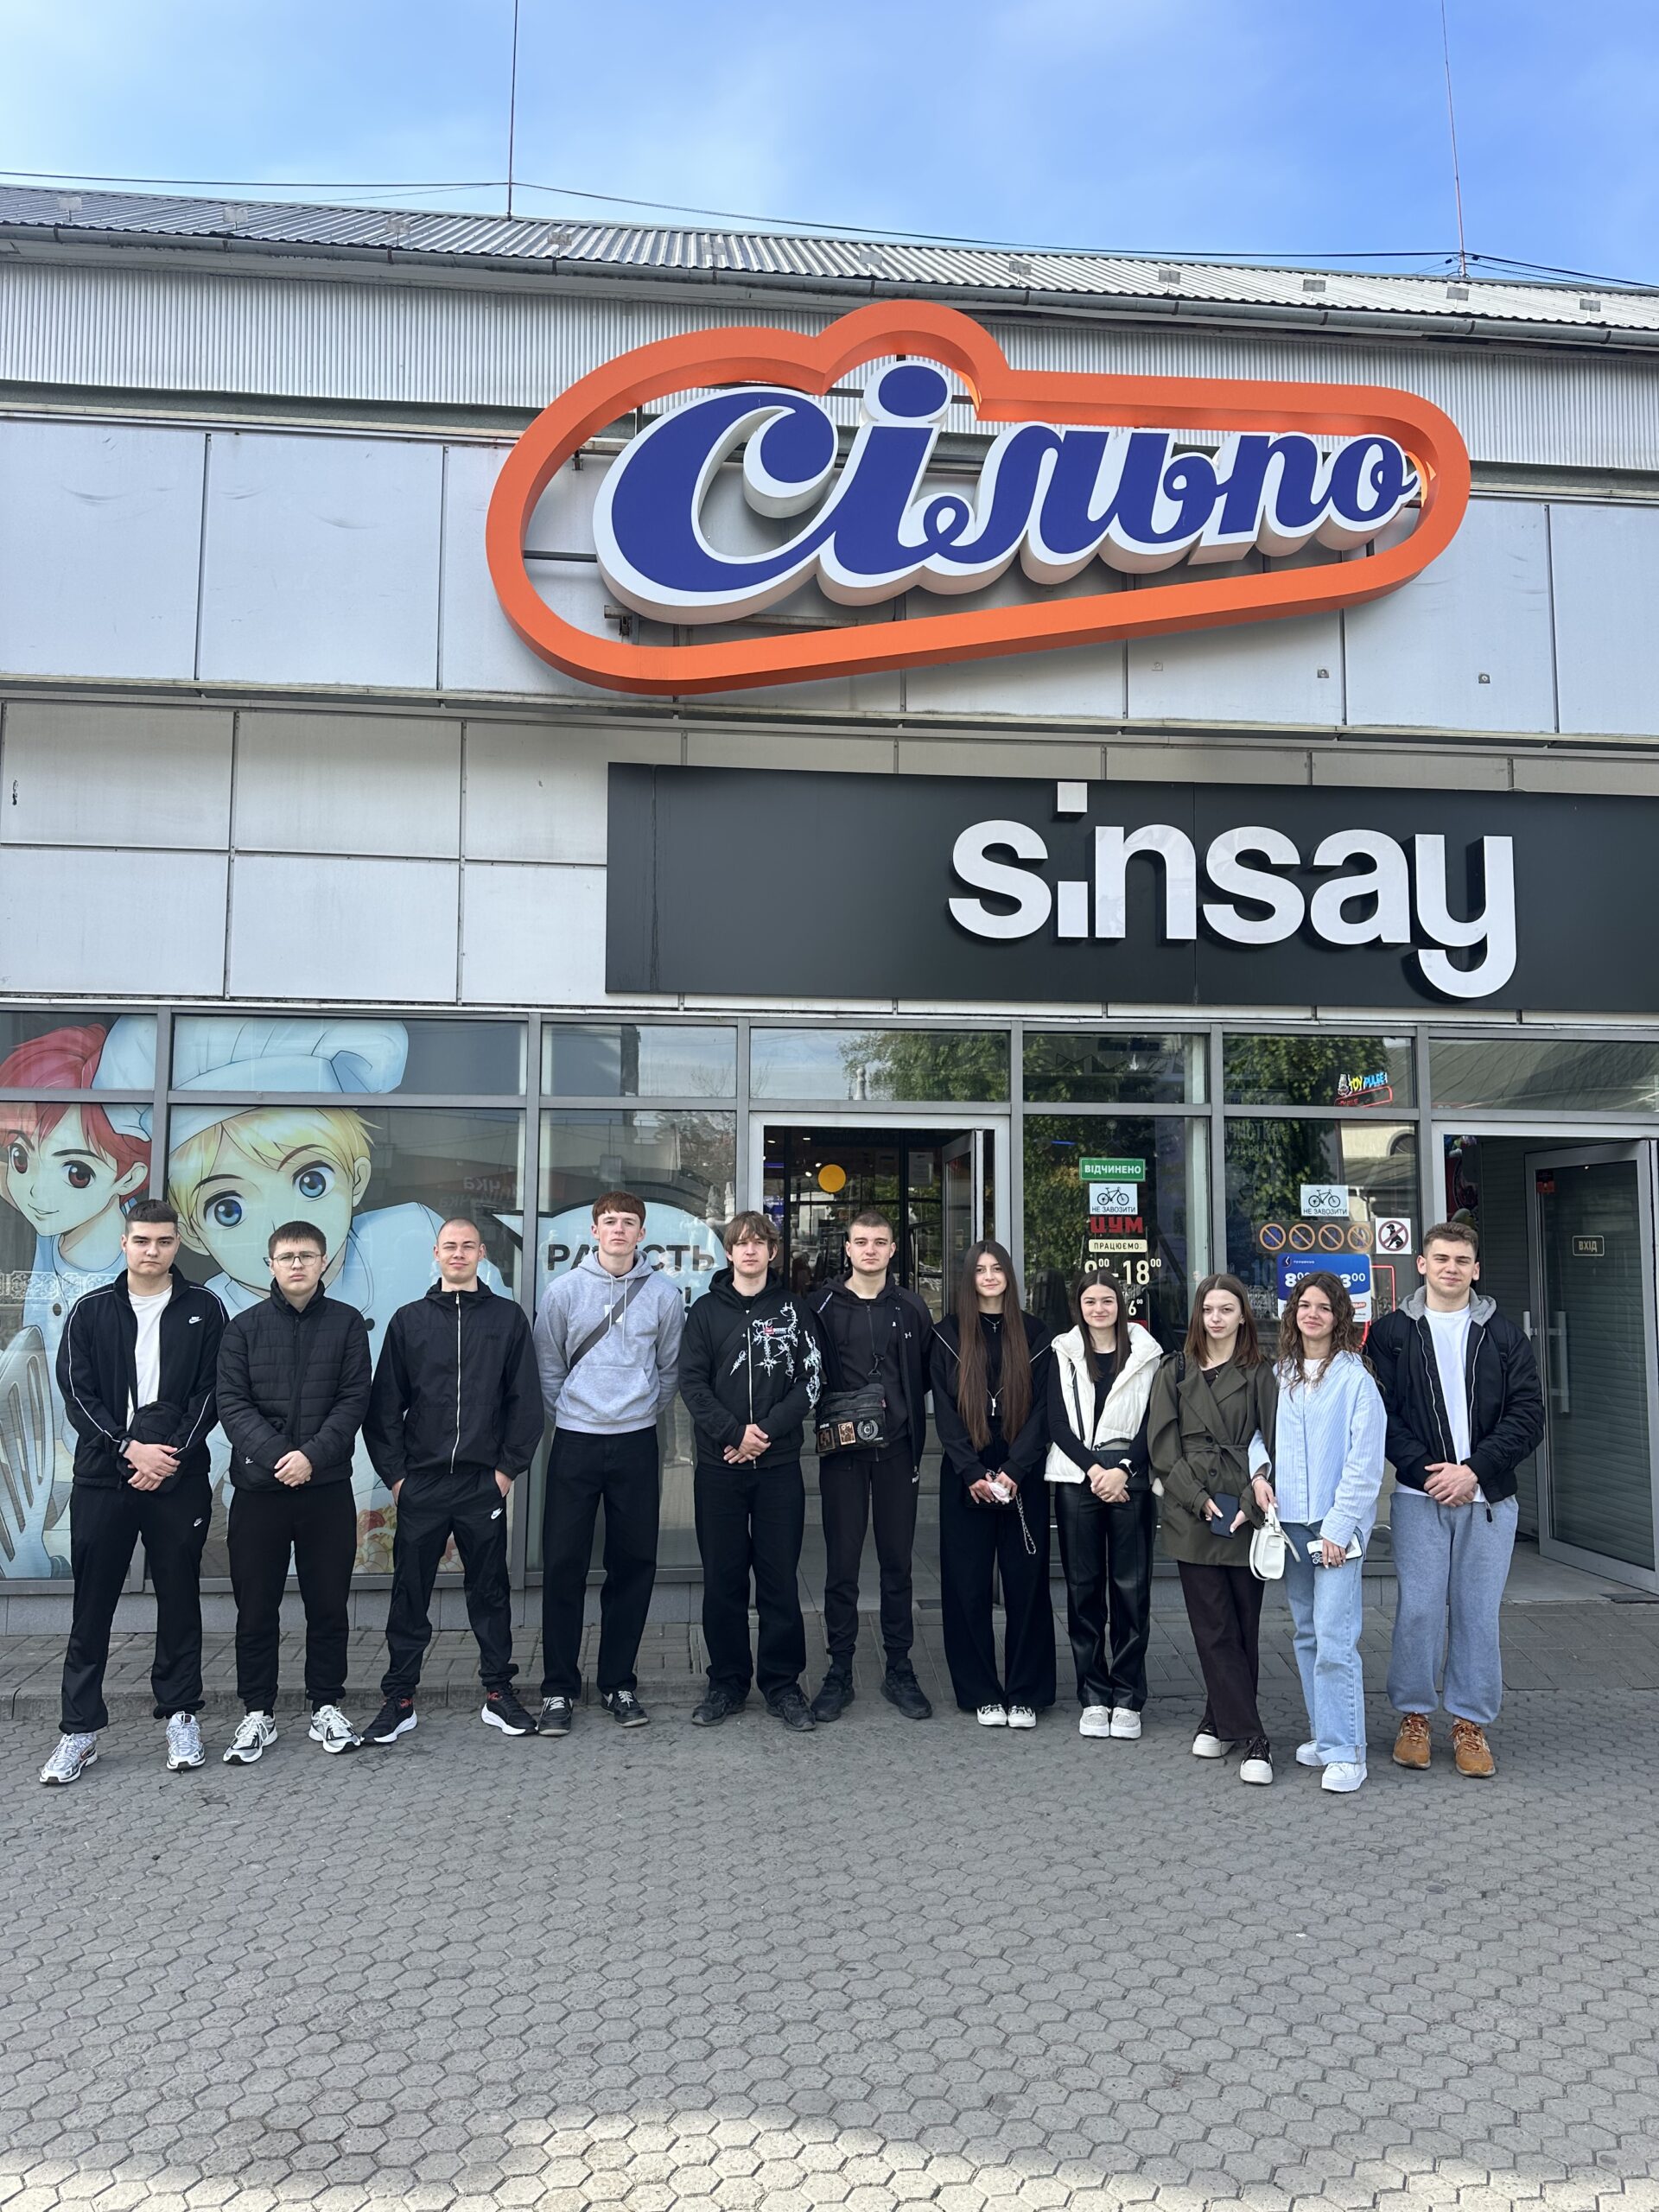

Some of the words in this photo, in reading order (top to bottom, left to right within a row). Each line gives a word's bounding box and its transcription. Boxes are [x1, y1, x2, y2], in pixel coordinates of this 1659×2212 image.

[594, 359, 1421, 617] Сільпо
[949, 781, 1518, 998] sinsay
[1084, 1165, 1141, 1174] ВІДЧИНЕНО
[1090, 1217, 1143, 1233] ЦУМ
[1579, 1241, 1598, 1252] ВХІД
[547, 1244, 715, 1271] РАСТЬ
